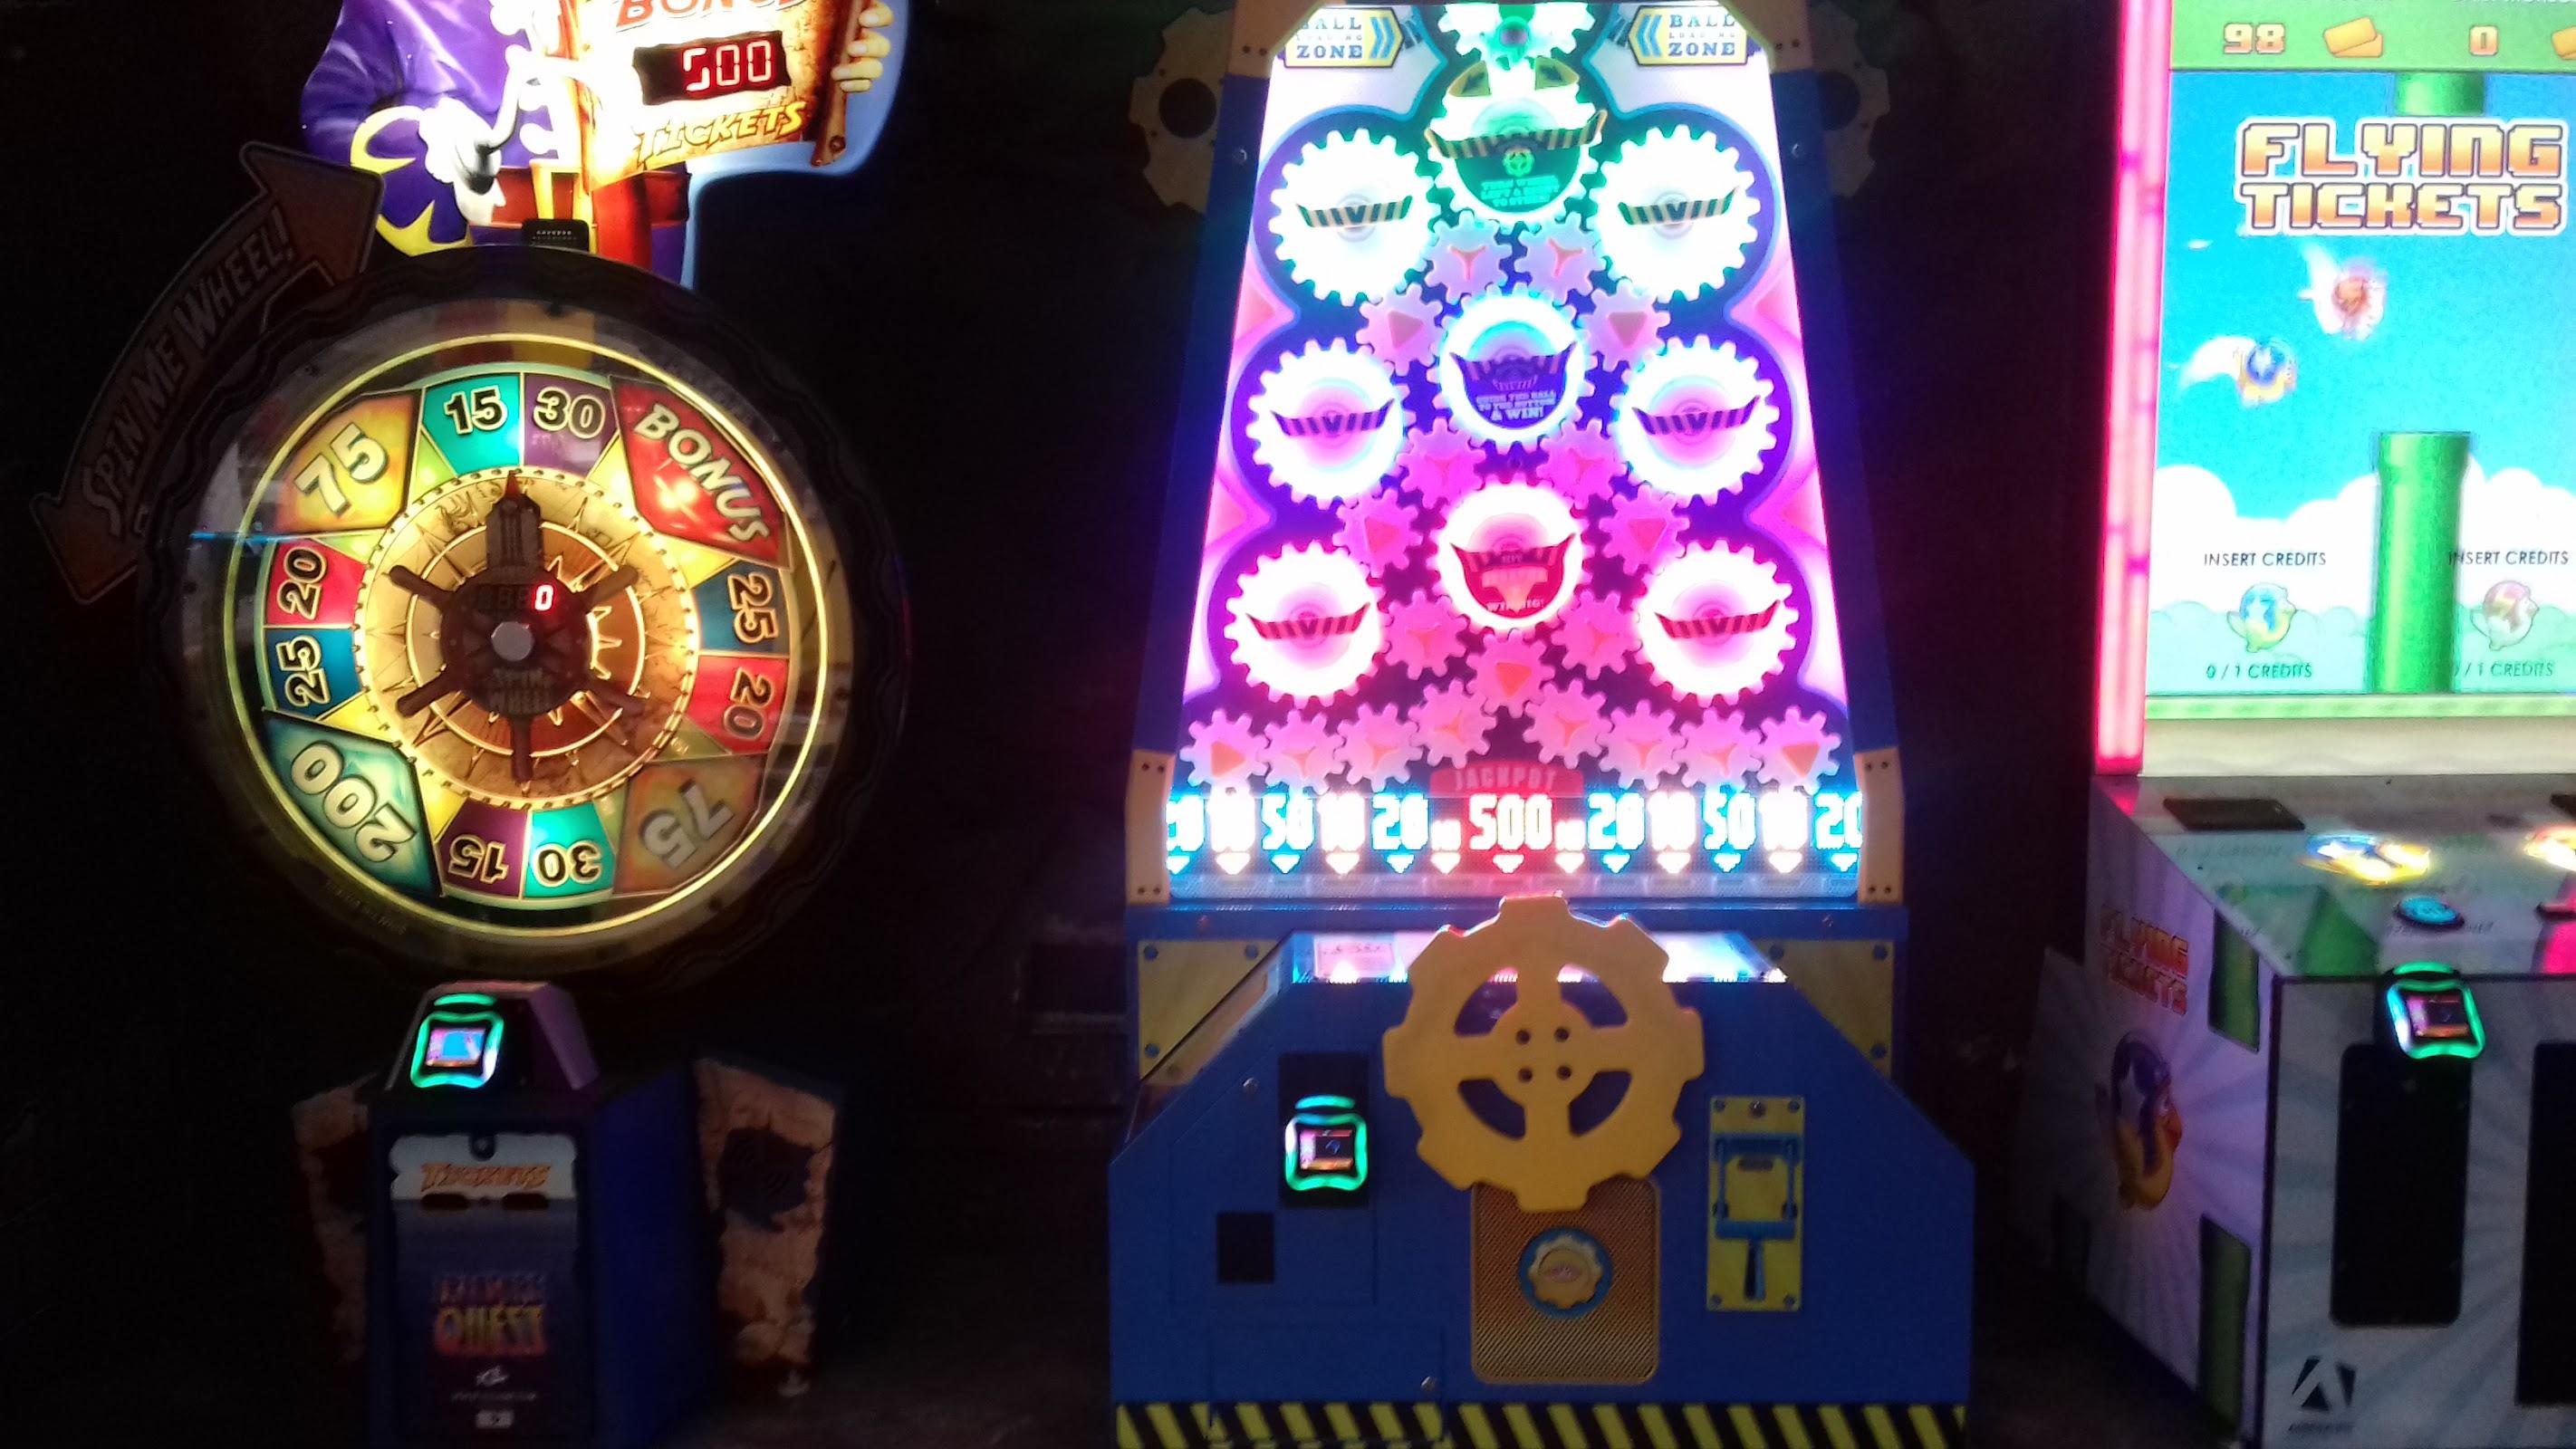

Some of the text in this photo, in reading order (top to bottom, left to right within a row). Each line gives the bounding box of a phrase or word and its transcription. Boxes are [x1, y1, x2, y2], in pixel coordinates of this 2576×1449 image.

[1669, 14, 1735, 28] BALL
[2223, 22, 2287, 54] 98
[2468, 24, 2499, 56] 0
[683, 40, 771, 91] 500
[1296, 45, 1363, 59] ZONE
[1668, 43, 1735, 56] ZONE
[632, 101, 807, 170] TICKETS
[2242, 122, 2563, 178] FLYING
[2240, 183, 2563, 230] TICKETS
[84, 205, 294, 538] SPIN ME WHEEL!
[445, 388, 507, 435] 15
[533, 388, 605, 439] 30
[294, 422, 389, 517] 75
[634, 404, 770, 544] BONUS
[2204, 551, 2327, 567] INSERT CREDITS
[2447, 550, 2570, 566] INSERT CREDITS
[277, 548, 328, 620] 20
[534, 584, 554, 611] 0
[727, 571, 780, 645] 25
[275, 634, 332, 708] 25
[2206, 665, 2216, 679] 0
[2234, 665, 2242, 679] 1
[2247, 663, 2313, 679] CREDITS
[2491, 662, 2555, 678] CREDITS
[724, 667, 775, 741] 20
[290, 741, 418, 864] 200
[1455, 765, 1558, 792] JACKPOT
[639, 780, 735, 870] 75
[1261, 793, 1315, 850] 50
[1371, 793, 1430, 851] 20
[1470, 792, 1554, 850] 500
[1587, 792, 1646, 850] 20
[1702, 791, 1756, 849] 50
[448, 834, 510, 886] 15
[533, 841, 603, 883] 30
